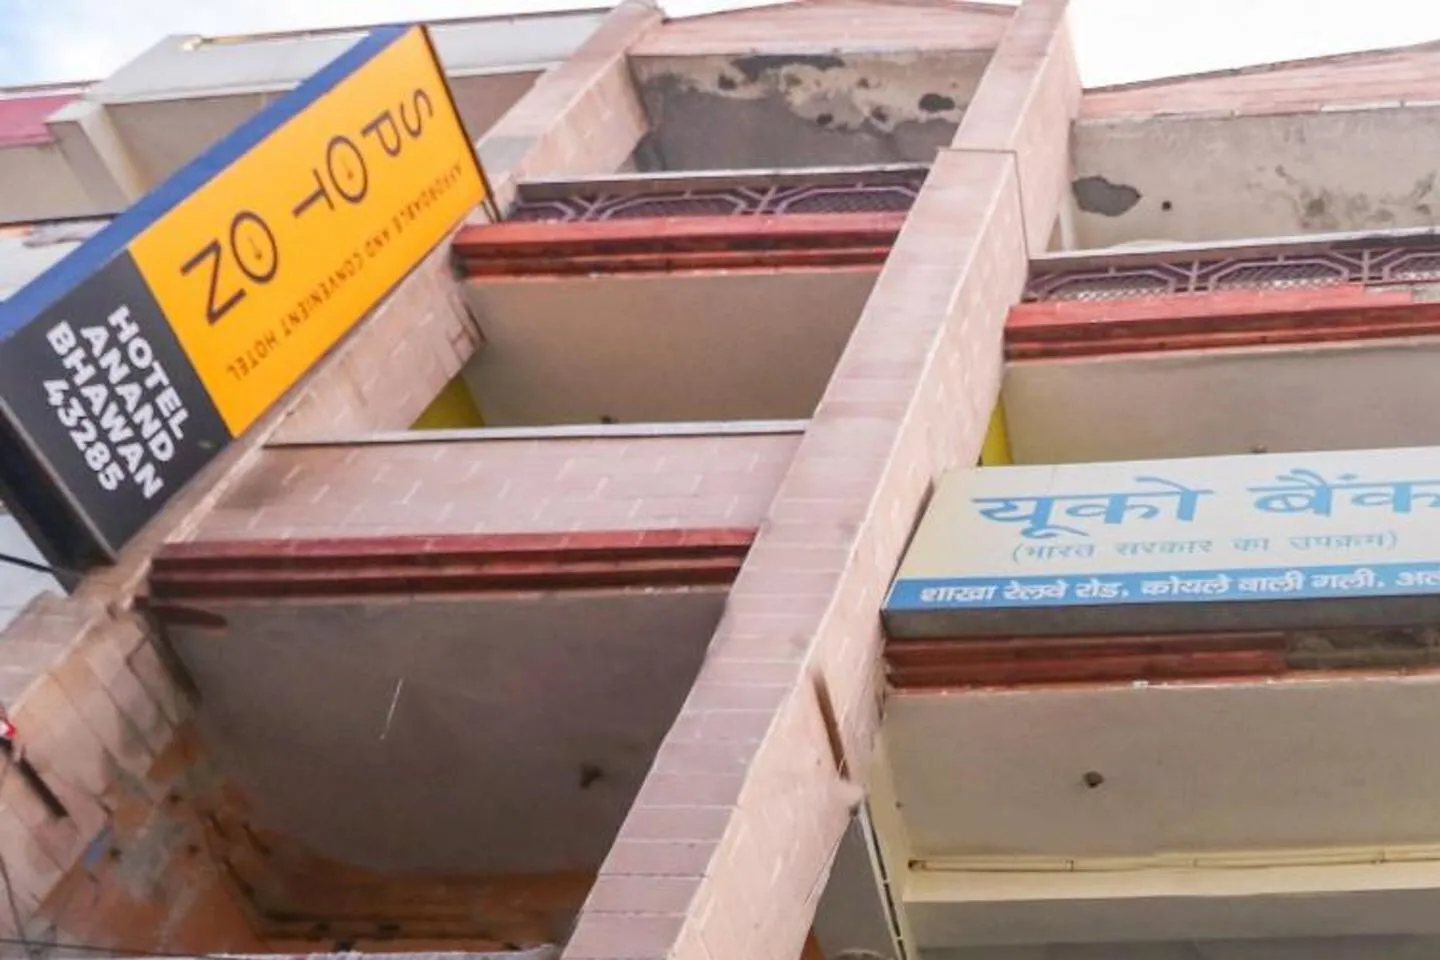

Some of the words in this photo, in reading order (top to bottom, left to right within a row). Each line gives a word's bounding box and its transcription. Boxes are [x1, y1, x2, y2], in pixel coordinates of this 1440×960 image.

[292, 87, 435, 218] SPOT
[180, 210, 278, 326] ON
[45, 320, 163, 499] BHAWAN
[80, 323, 174, 462] ANAND
[108, 304, 188, 440] HOTEL
[225, 330, 278, 381] HOTEL
[43, 377, 124, 492] 43285
[971, 476, 1214, 538] यूको
[1012, 541, 1095, 564] (भारत
[1113, 539, 1213, 556] सरकार
[1232, 536, 1270, 552] का
[920, 583, 997, 602] शाखा
[1004, 579, 1071, 600] रेलवे
[1140, 574, 1230, 597] कोयले
[1239, 569, 1303, 593] वाली
